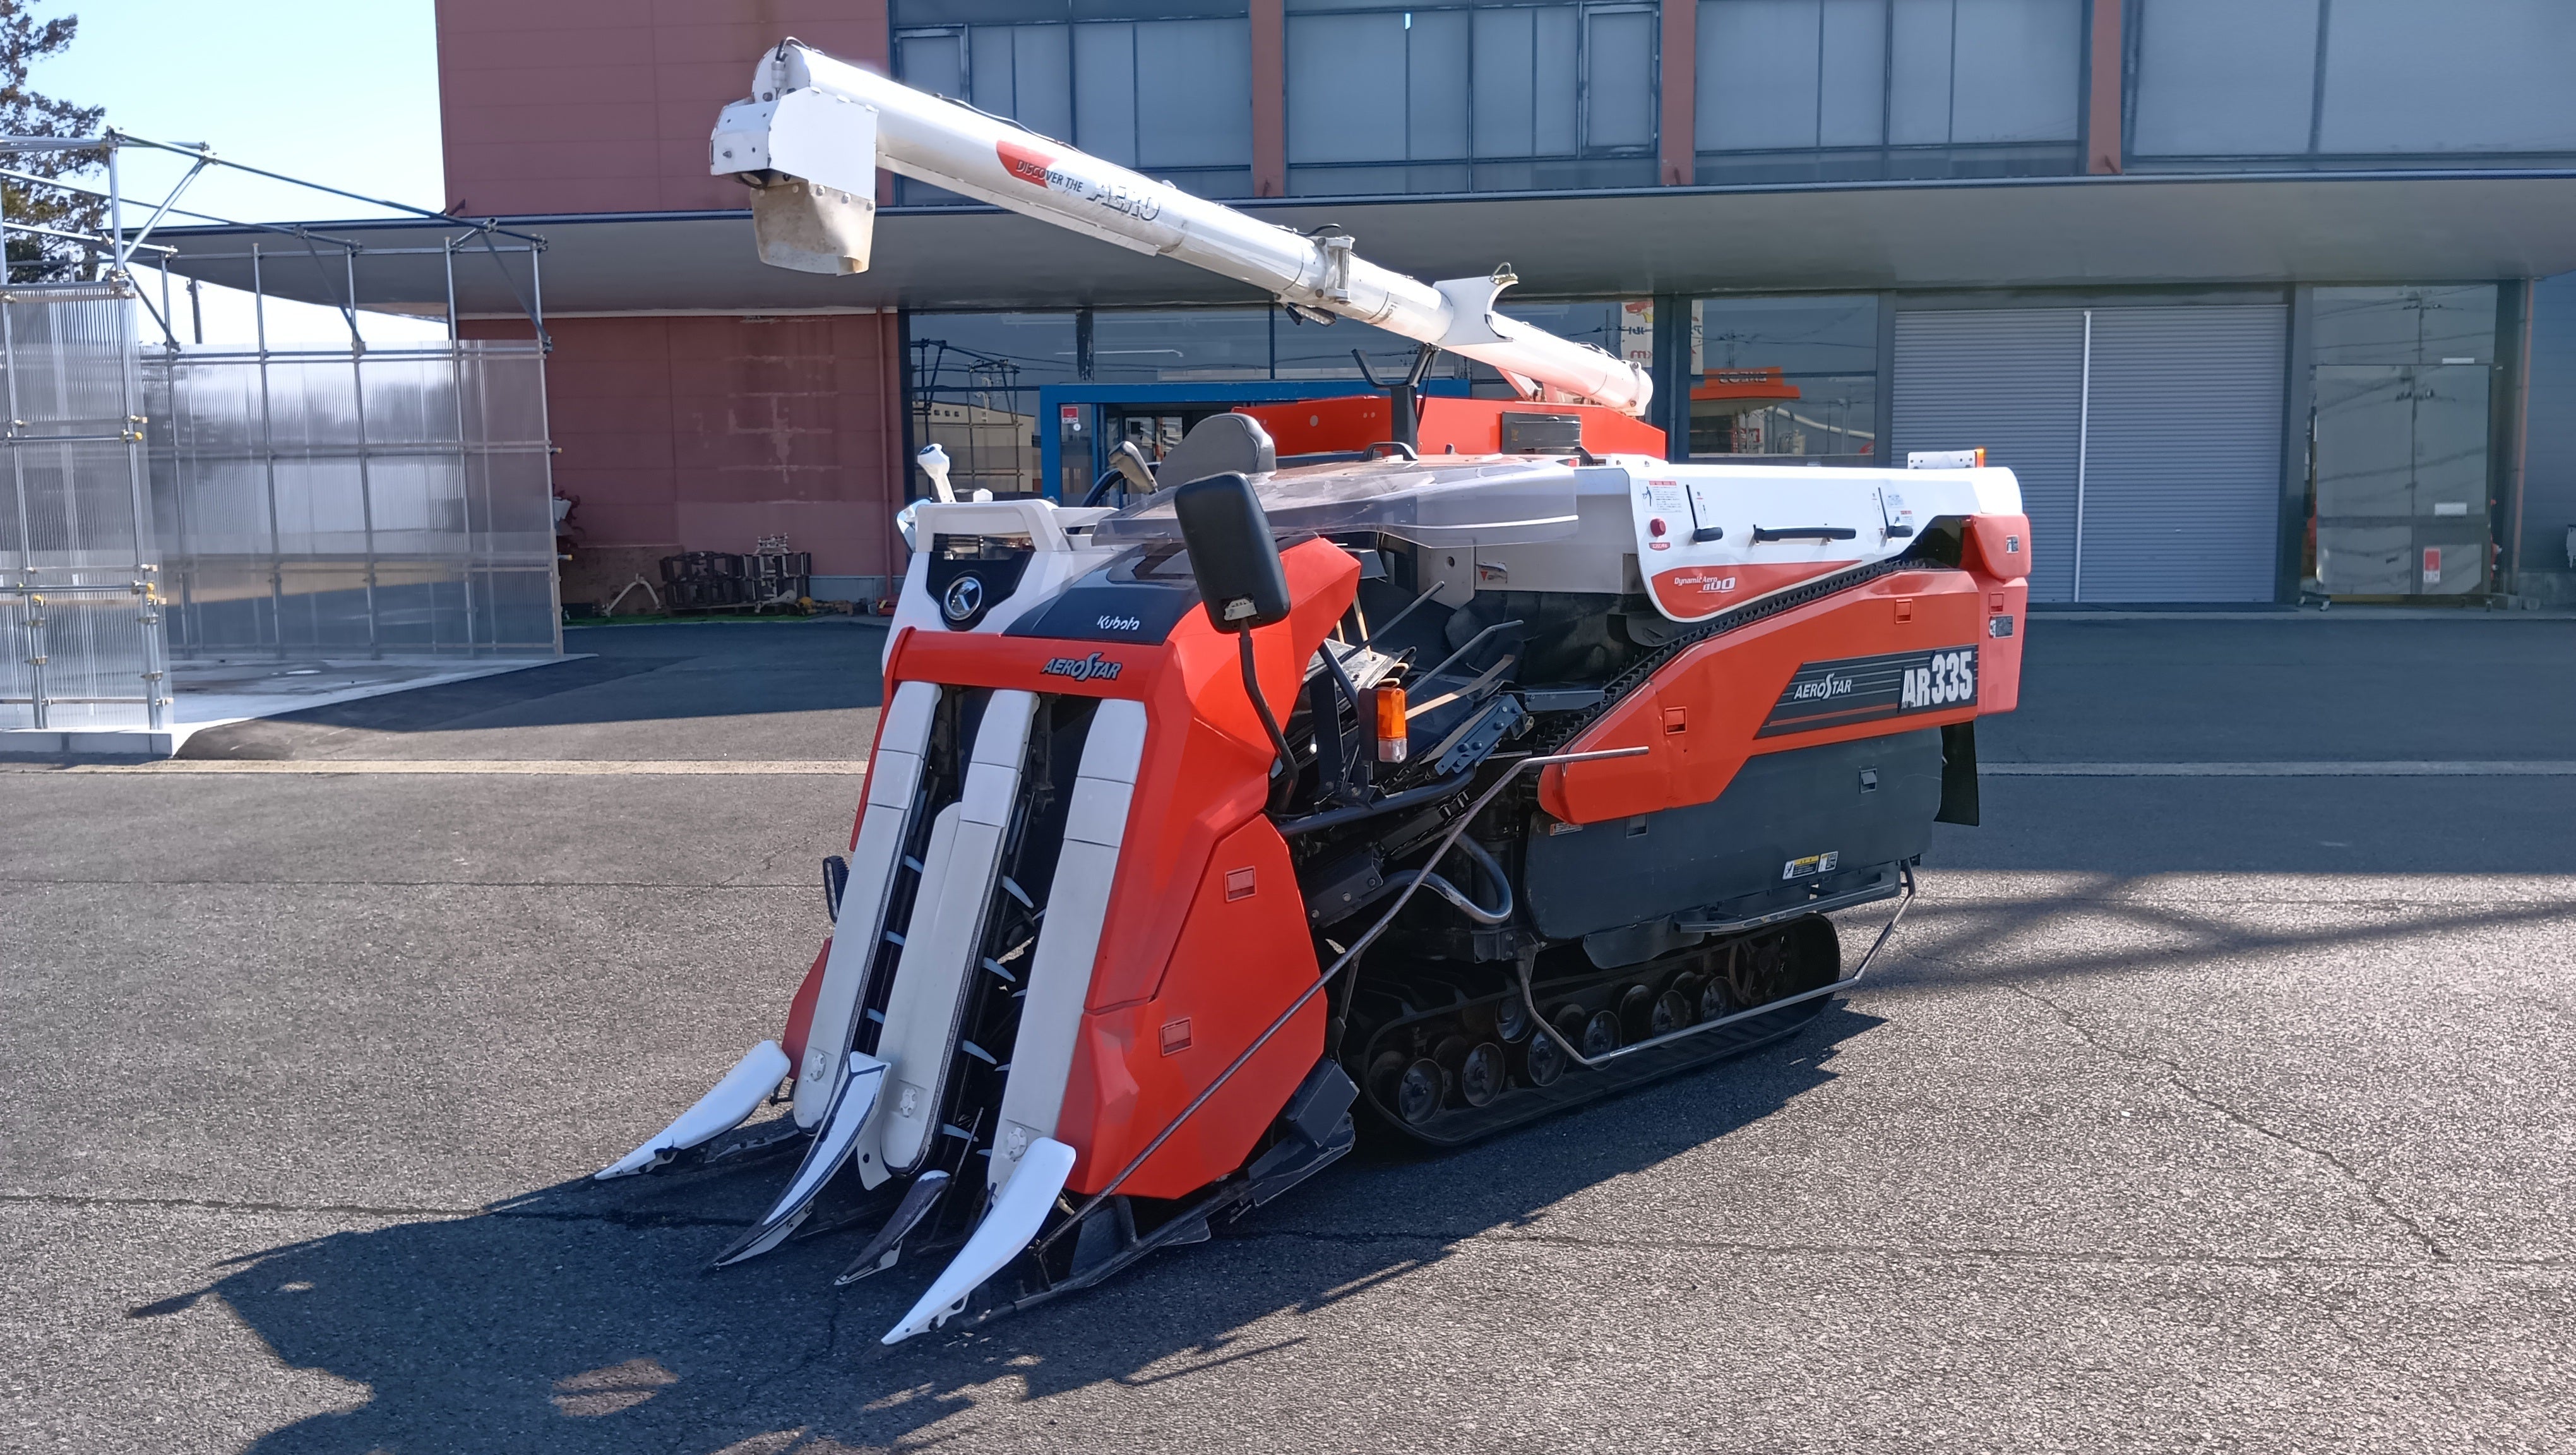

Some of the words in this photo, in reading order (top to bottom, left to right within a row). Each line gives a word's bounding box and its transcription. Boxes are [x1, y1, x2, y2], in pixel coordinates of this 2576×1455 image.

[1017, 160, 1063, 186] DISCOVER
[1065, 177, 1084, 193] THE
[1086, 182, 1160, 221] AERO
[1674, 575, 1703, 586] Dynamic
[1702, 575, 1718, 584] Aero
[1097, 614, 1140, 631] Kubota
[1040, 652, 1123, 681] AEROSTAR
[1900, 650, 1973, 710] AR335
[1793, 673, 1852, 700] AEROSTAR
